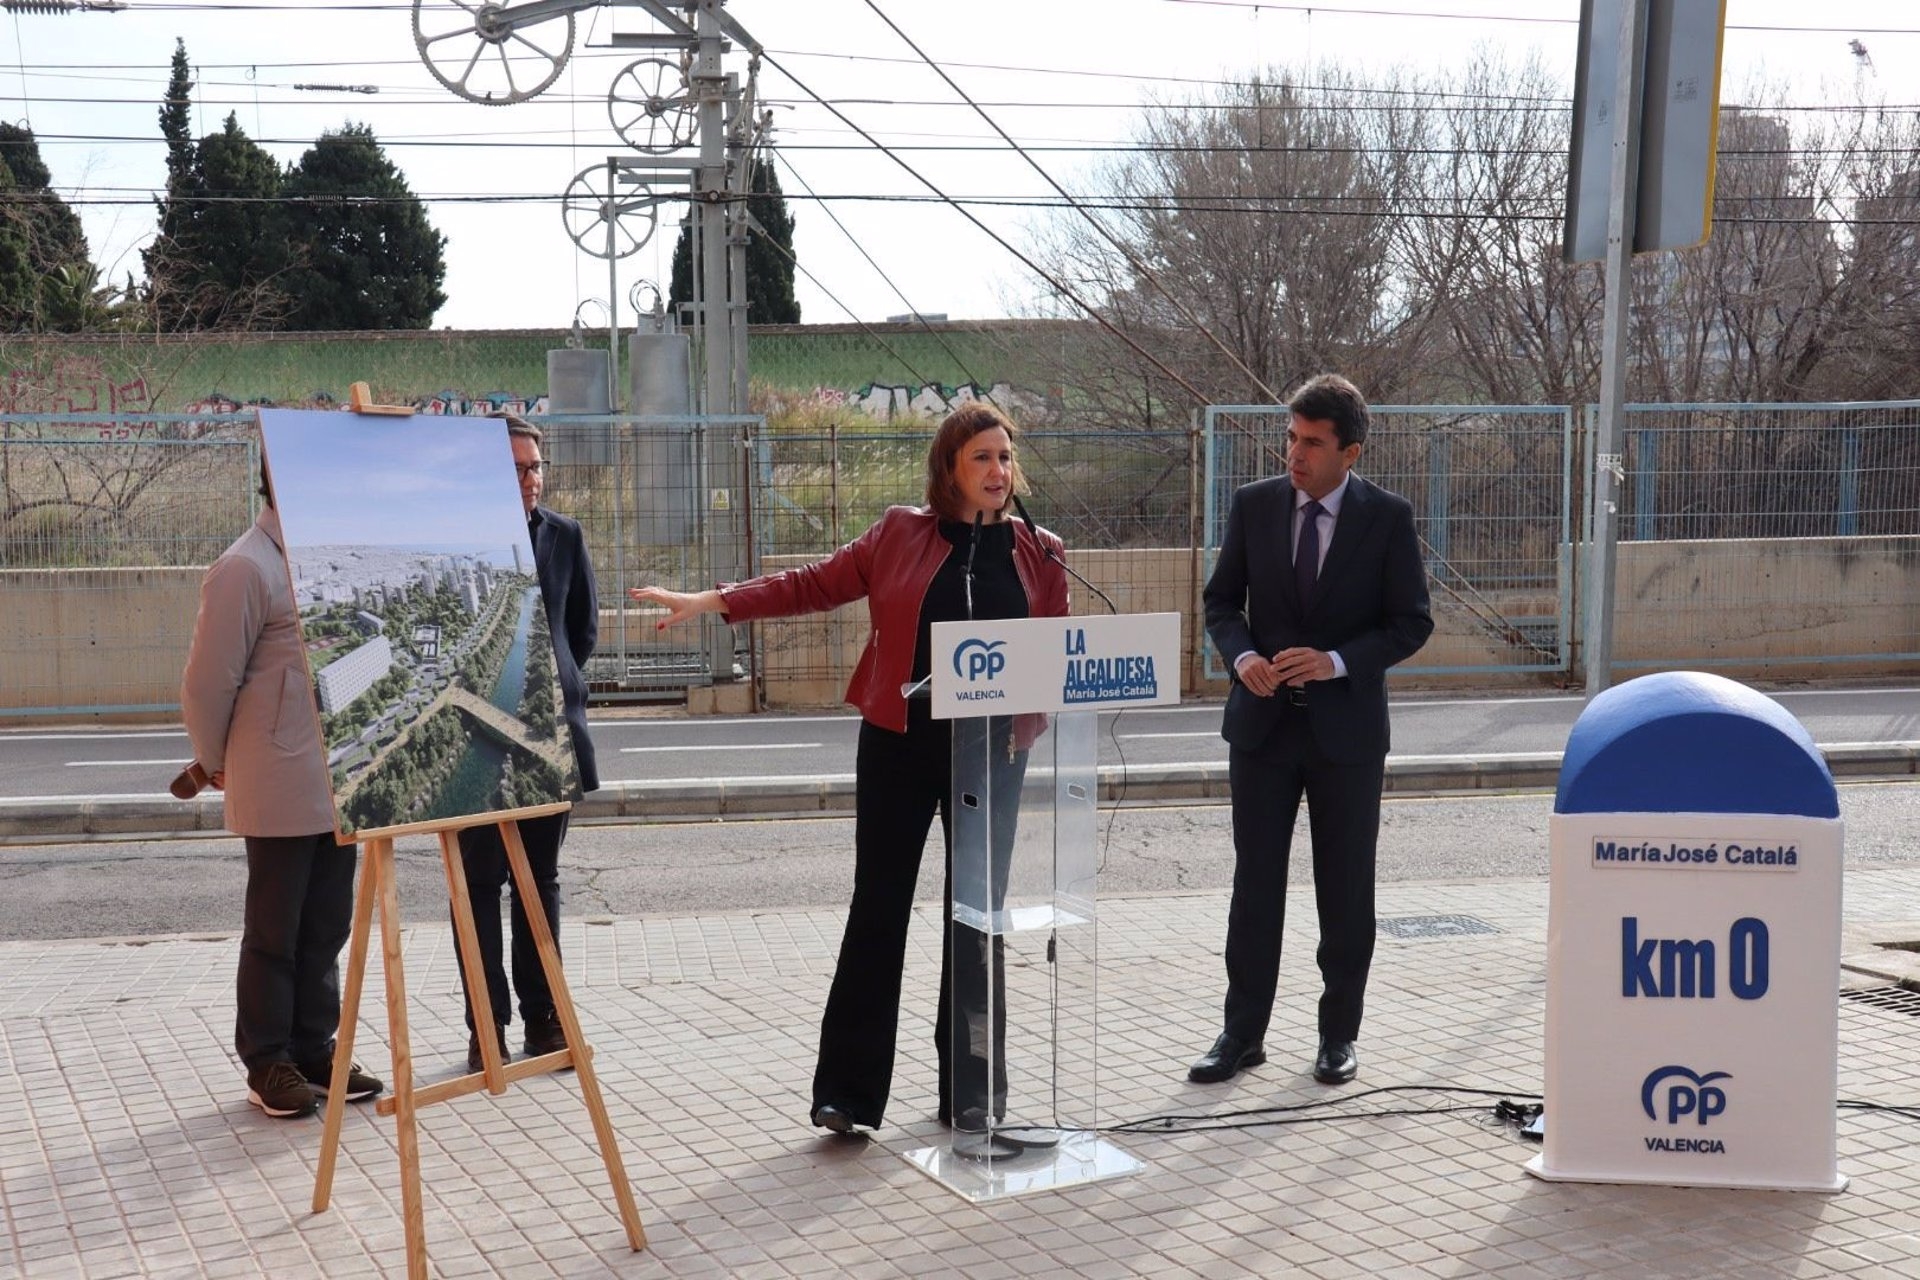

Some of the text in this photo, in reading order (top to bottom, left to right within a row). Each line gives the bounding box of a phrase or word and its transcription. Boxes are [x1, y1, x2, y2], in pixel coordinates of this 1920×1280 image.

[1066, 629, 1086, 655] LA
[1066, 656, 1155, 686] ALCALDESA
[956, 690, 1005, 700] VALENCIA
[1066, 684, 1154, 699] María José Catalá
[1595, 842, 1797, 865] María José Catalá
[1622, 917, 1769, 1000] km 0
[1644, 1137, 1725, 1153] VALENCIA
